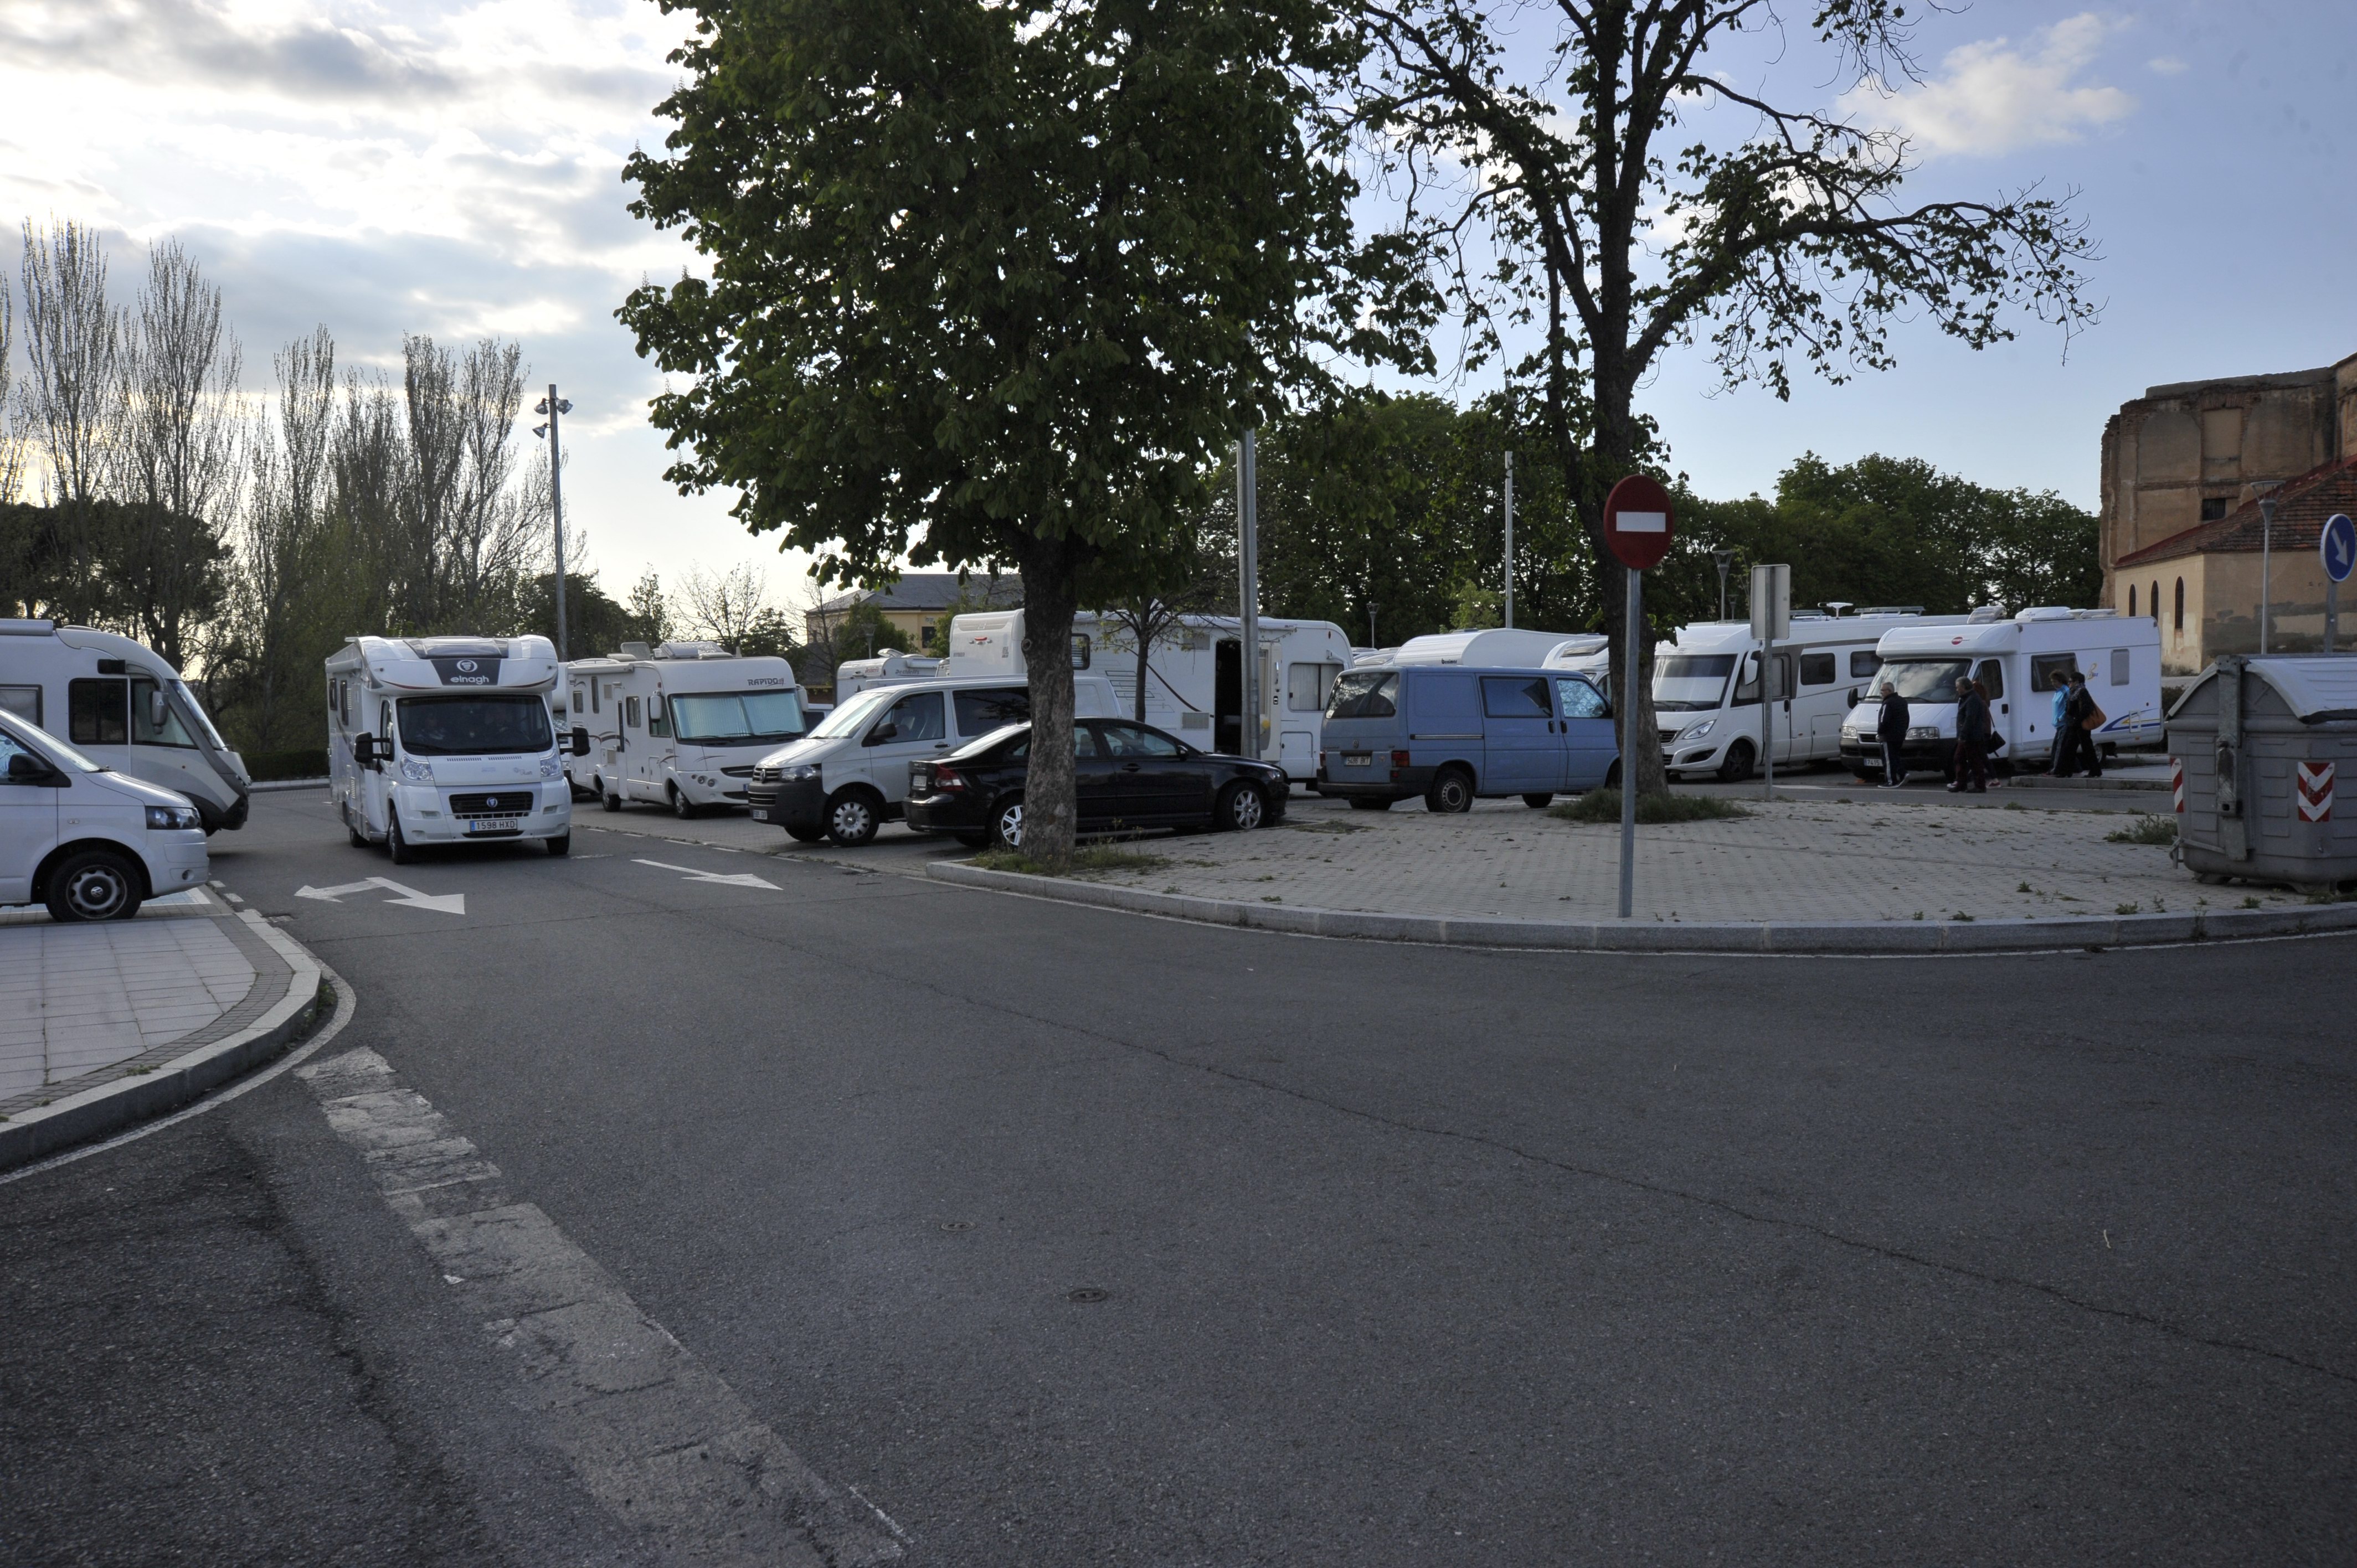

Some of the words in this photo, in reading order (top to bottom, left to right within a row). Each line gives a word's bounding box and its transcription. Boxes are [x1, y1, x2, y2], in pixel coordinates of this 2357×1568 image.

[450, 675, 489, 685] elnagh
[747, 678, 778, 686] RAPIDO
[499, 821, 515, 829] HXD
